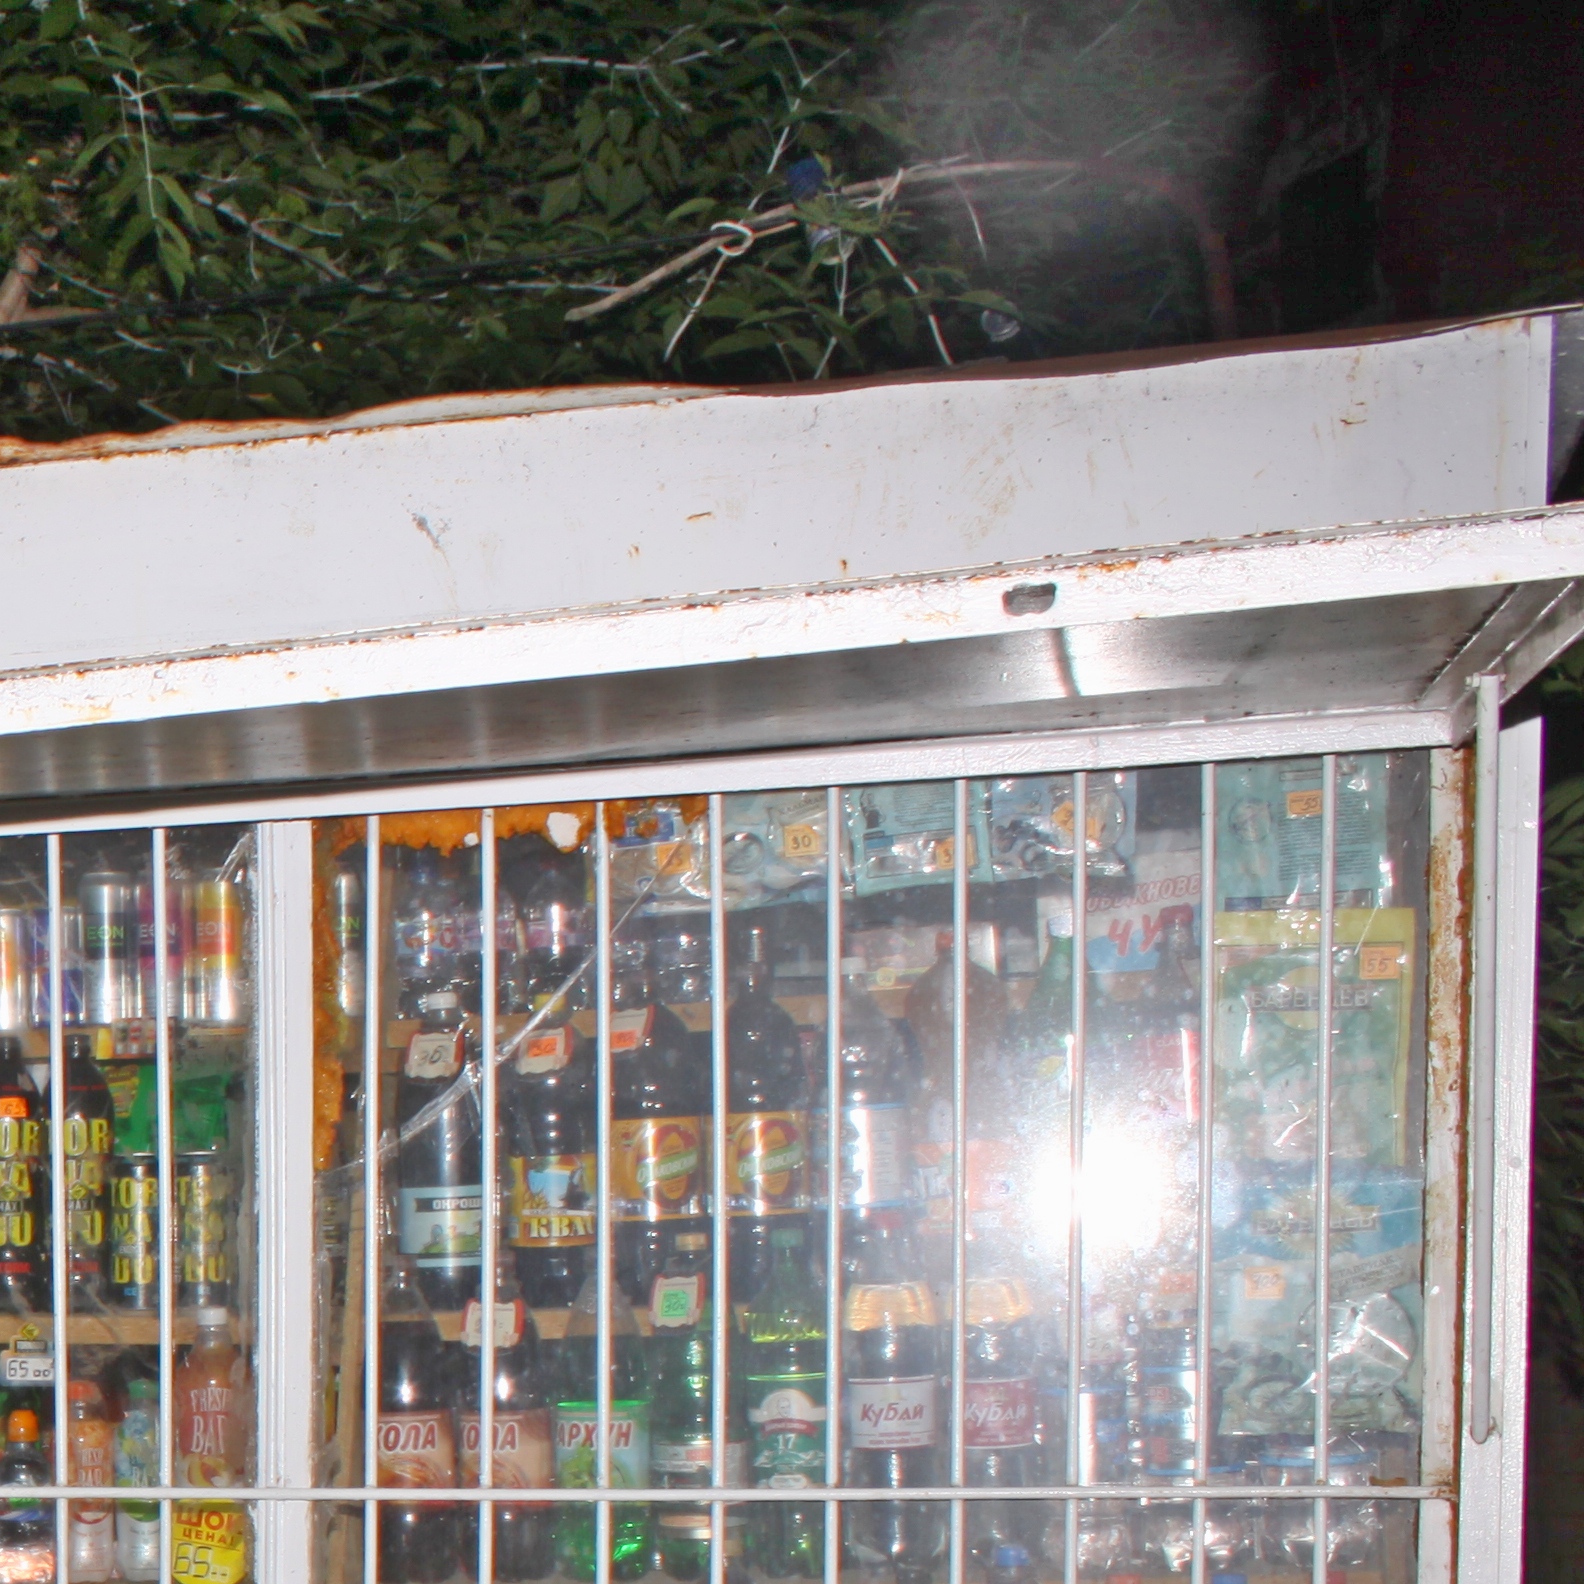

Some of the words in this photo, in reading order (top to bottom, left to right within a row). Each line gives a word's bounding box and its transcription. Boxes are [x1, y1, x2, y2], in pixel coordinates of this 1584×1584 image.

[87, 925, 124, 940] EON
[1253, 988, 1369, 1009] БАРЕНЕВ
[432, 1197, 482, 1209] ОКРОШ
[556, 1421, 633, 1450] АРХУН
